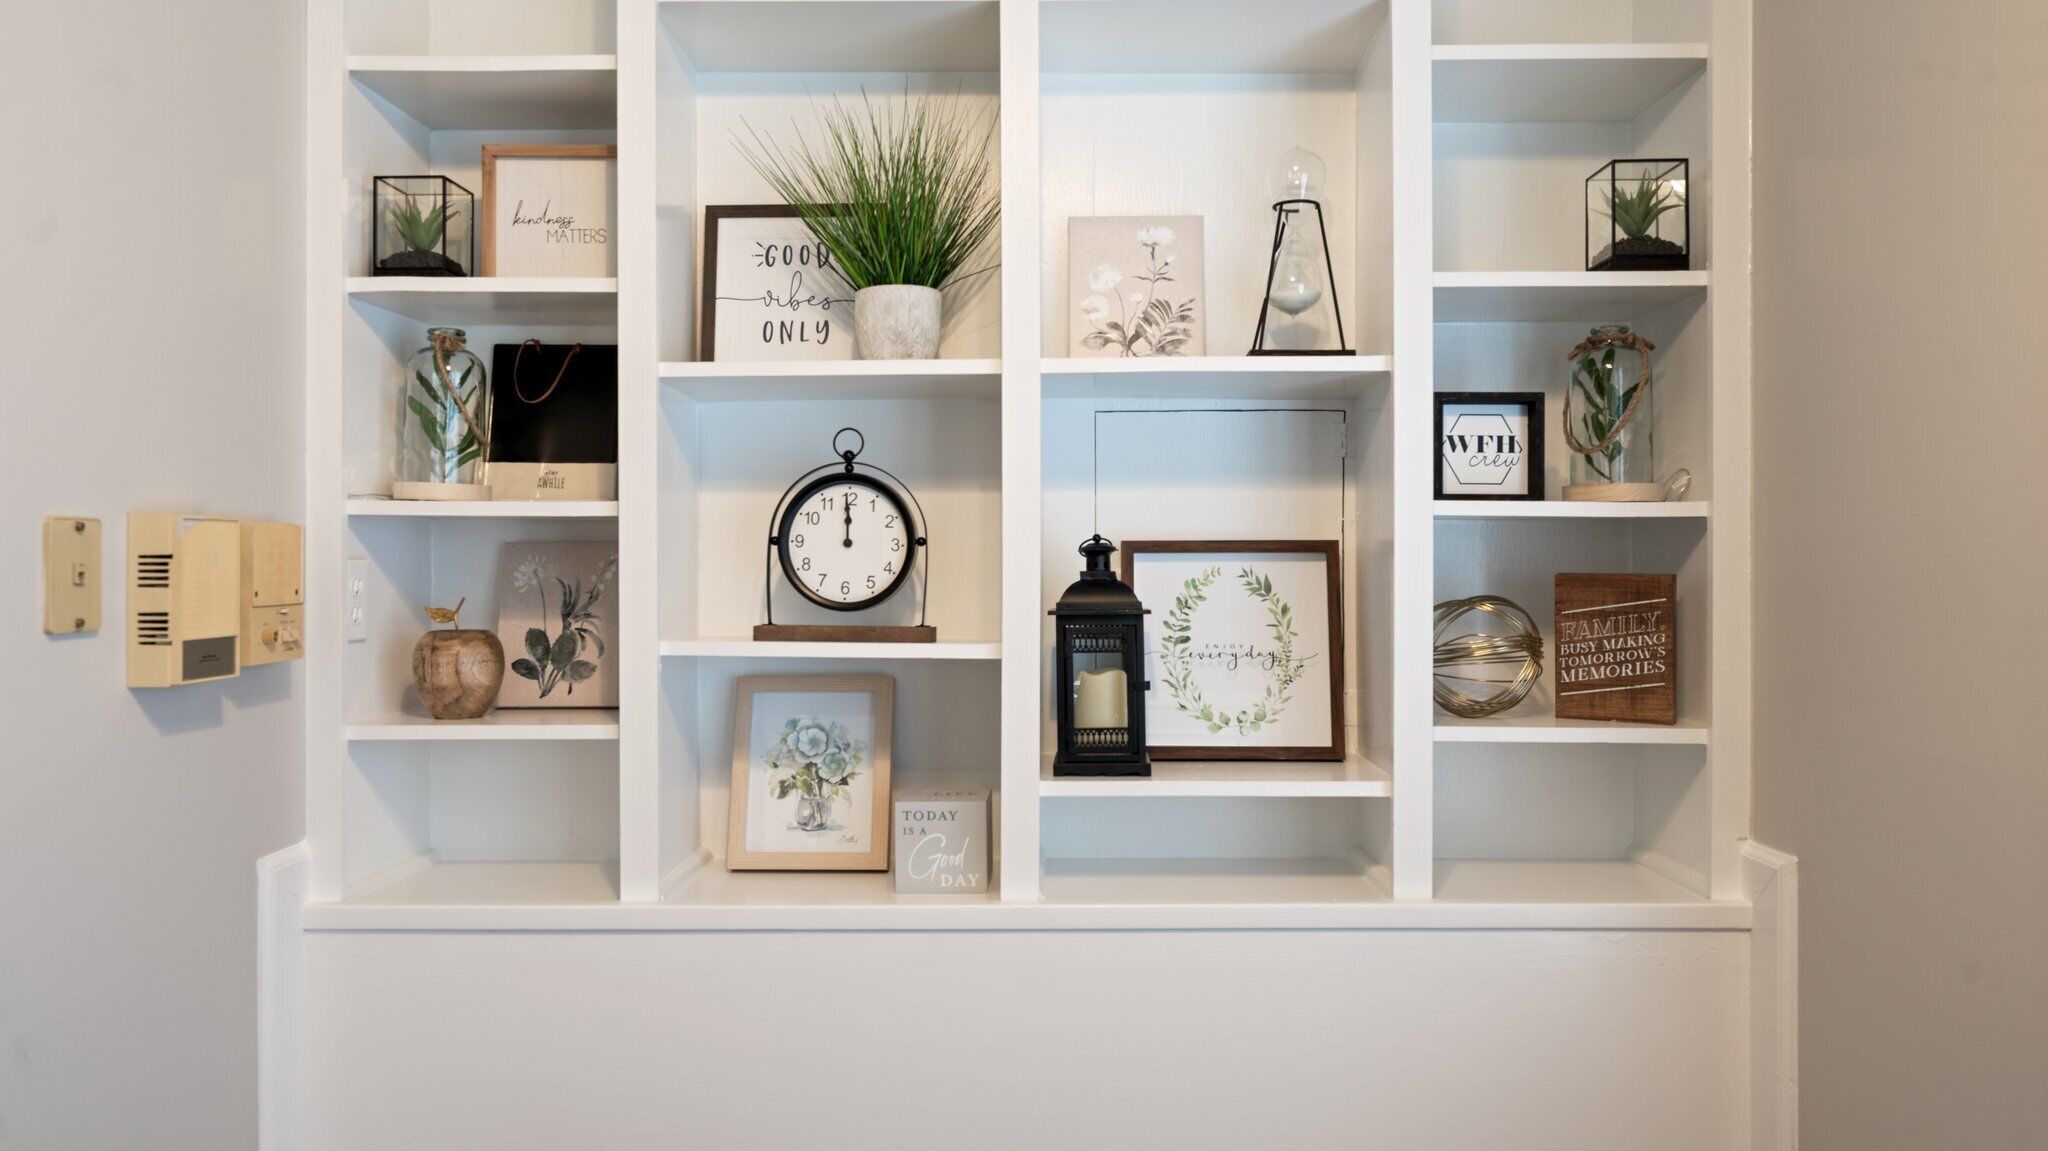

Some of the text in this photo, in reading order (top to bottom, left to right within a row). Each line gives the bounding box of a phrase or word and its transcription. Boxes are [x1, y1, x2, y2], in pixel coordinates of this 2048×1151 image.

[512, 199, 575, 229] kindness
[546, 228, 608, 244] MATTERS
[764, 242, 831, 269] GOOD
[760, 270, 832, 312] vibes
[762, 319, 831, 345] ONLY
[1446, 435, 1517, 454] WFH
[1468, 454, 1520, 468] crew
[536, 476, 566, 489] AWHILE
[820, 498, 834, 511] 11
[842, 493, 858, 506] 12
[869, 499, 876, 513] 1
[804, 511, 820, 526] 10
[884, 514, 894, 529] 2
[794, 534, 805, 548] 9
[890, 538, 900, 552] 3
[801, 557, 811, 571] 8
[883, 561, 892, 575] 4
[818, 573, 827, 587] 7
[866, 575, 876, 589] 5
[840, 581, 850, 595] 6
[1560, 633, 1665, 656] BUSY MAKING
[1188, 645, 1276, 672] everyday
[1559, 646, 1666, 668] TOMORROW'S
[1561, 659, 1666, 683] MEMORIES
[902, 810, 959, 821] TODAY
[903, 827, 927, 836] IS A
[908, 833, 970, 881] Good
[940, 873, 981, 888] DAY
